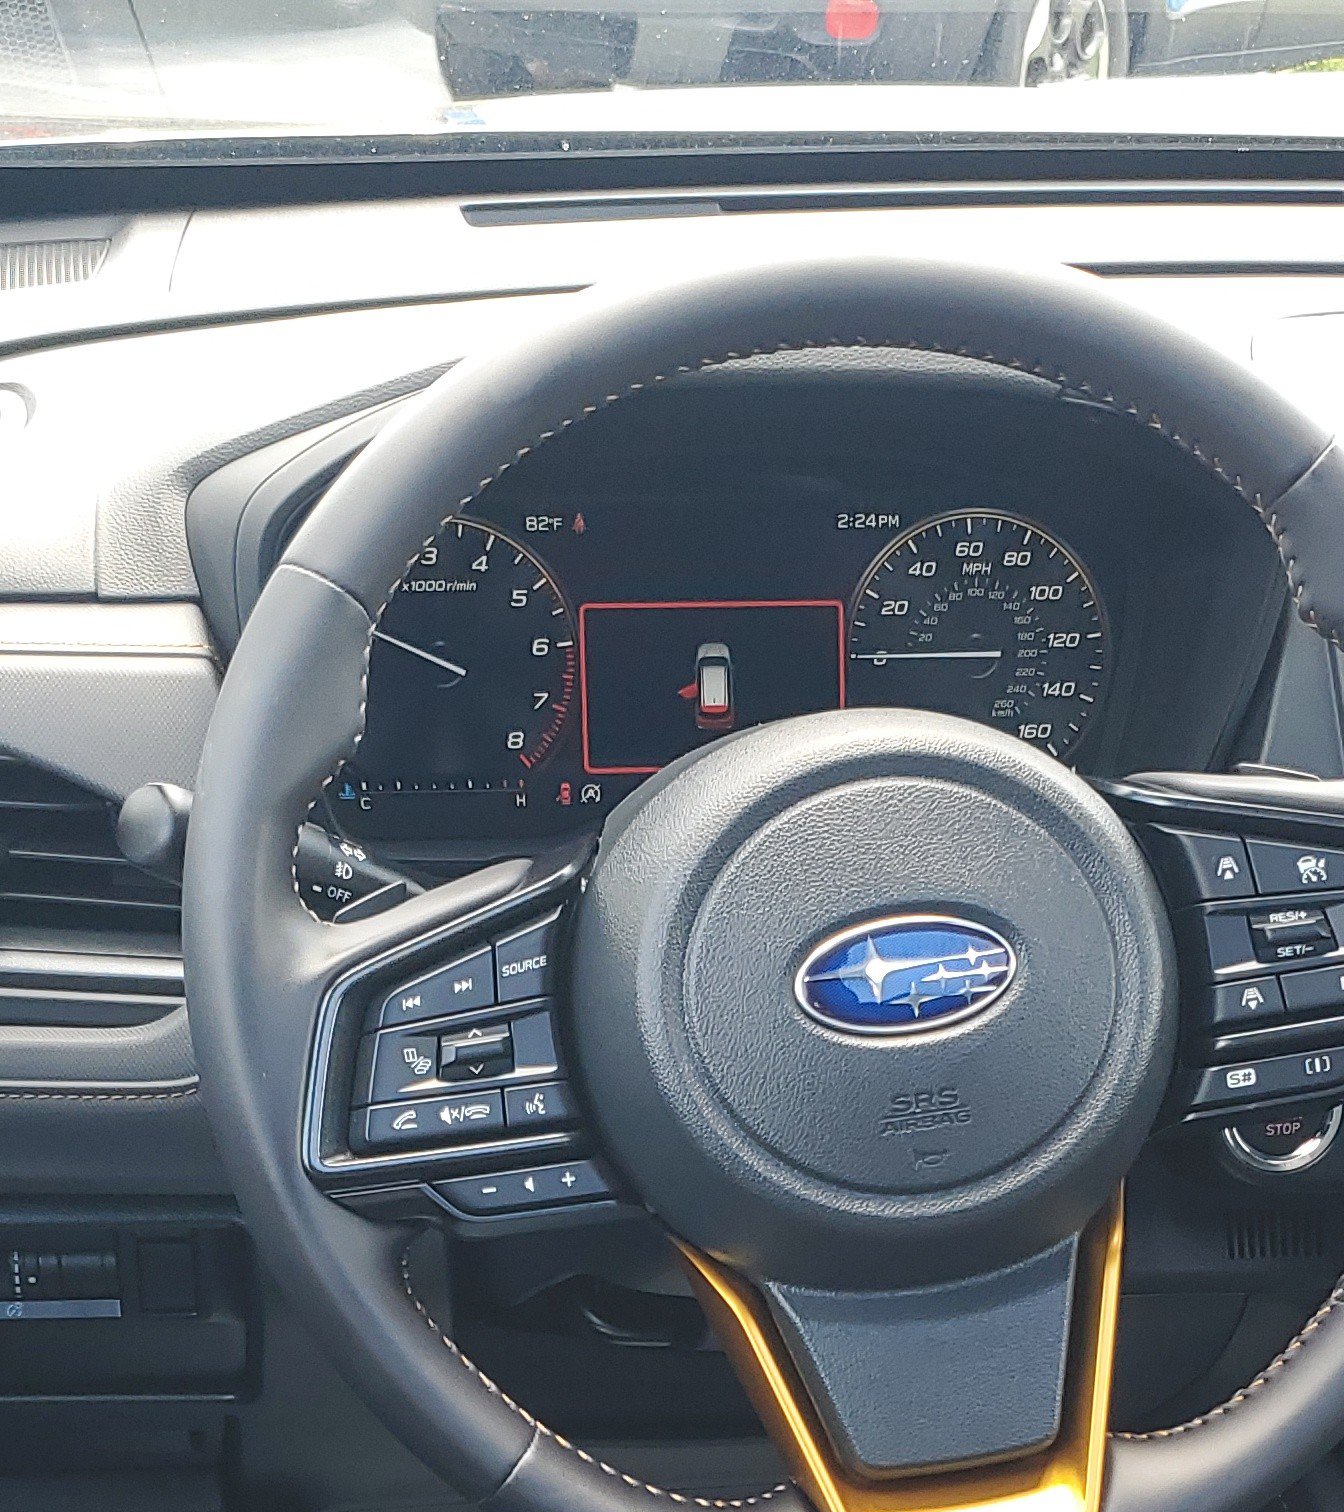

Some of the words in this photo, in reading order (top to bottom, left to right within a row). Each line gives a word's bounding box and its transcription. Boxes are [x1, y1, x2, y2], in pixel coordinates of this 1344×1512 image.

[421, 547, 438, 564] 3
[955, 541, 984, 557] 60
[472, 556, 489, 572] 4
[1003, 551, 1031, 566] 80
[908, 561, 937, 576] 40
[962, 562, 991, 576] MPH
[511, 591, 528, 607] 5
[1029, 585, 1063, 600] 100
[881, 600, 909, 615] 20
[532, 639, 549, 655] 6
[1046, 632, 1080, 648] 120
[1041, 682, 1075, 697] 140
[533, 692, 549, 709] 7
[1017, 723, 1052, 739] 160
[507, 732, 525, 749] 8
[360, 797, 372, 810] C
[516, 794, 527, 808] H
[326, 886, 353, 903] OFF
[502, 955, 548, 977] SOURCE
[890, 1088, 960, 1115] SRS
[1265, 1122, 1301, 1136] STOP
